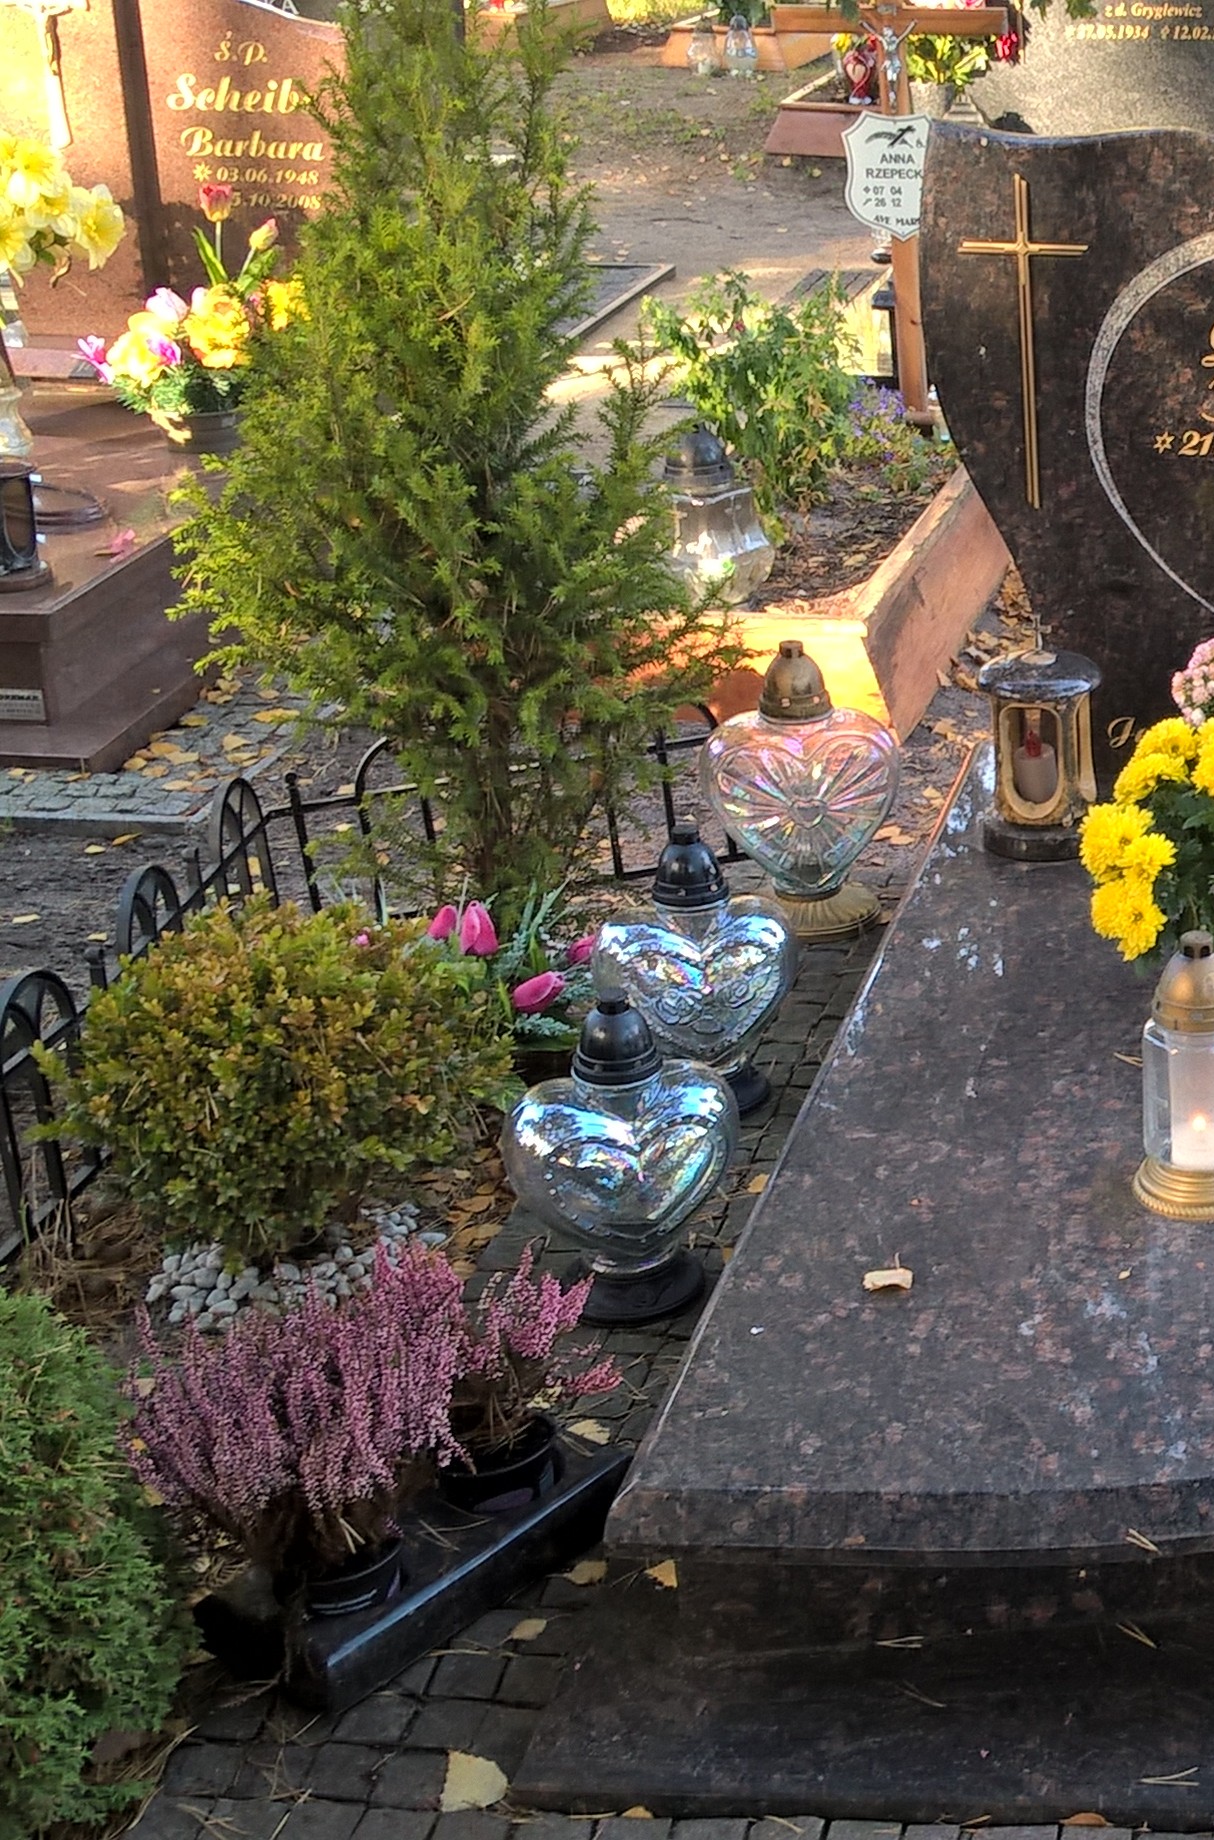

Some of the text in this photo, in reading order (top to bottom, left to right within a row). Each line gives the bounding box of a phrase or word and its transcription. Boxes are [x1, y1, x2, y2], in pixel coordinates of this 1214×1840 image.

[166, 73, 304, 114] Scheib
[180, 126, 326, 161] Barbara
[880, 153, 915, 164] ANNA
[866, 168, 923, 179] RZEPECK
[231, 191, 321, 209] 5.10.2008
[896, 217, 920, 227] MAR
